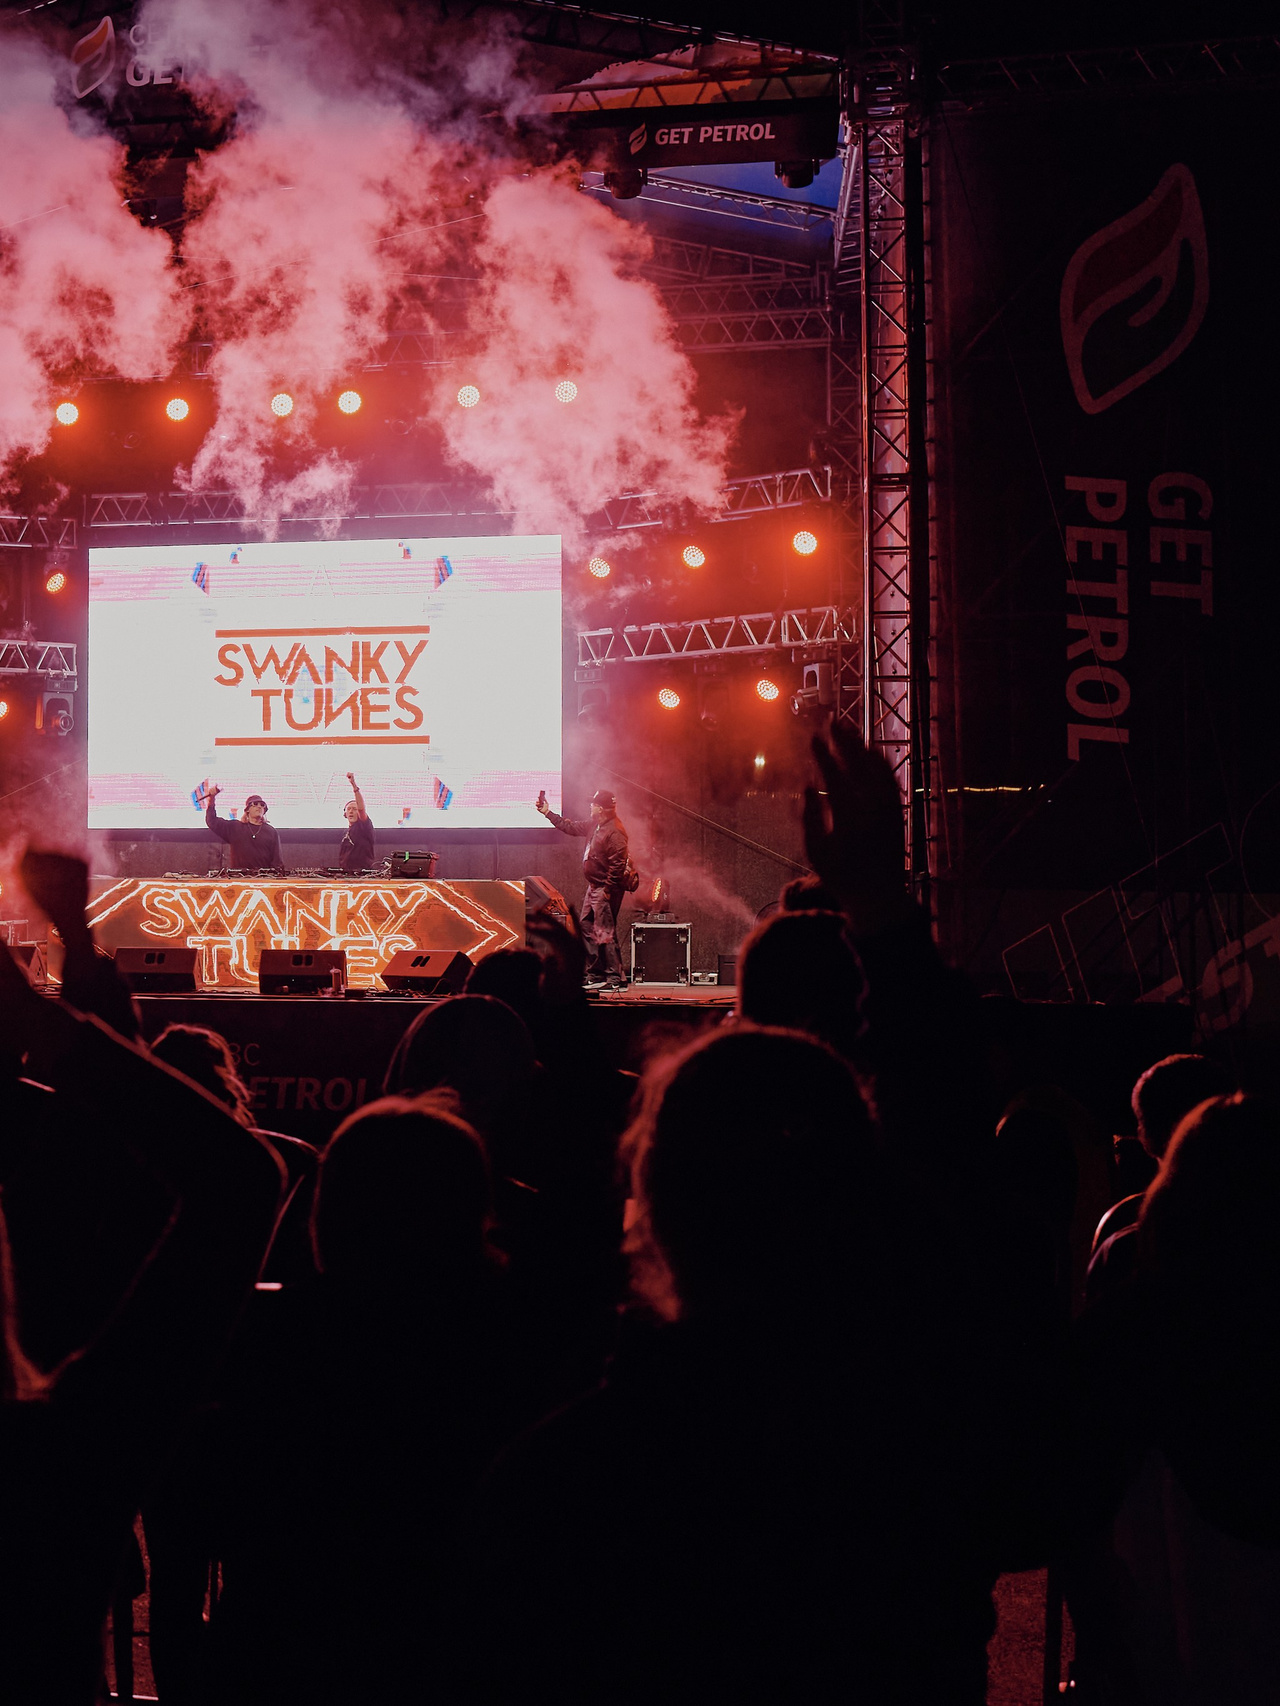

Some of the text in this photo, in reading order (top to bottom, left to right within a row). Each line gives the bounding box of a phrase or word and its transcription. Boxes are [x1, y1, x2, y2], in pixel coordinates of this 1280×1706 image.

[654, 122, 776, 146] GET PETROL
[1147, 470, 1214, 617] GET
[1064, 474, 1131, 762] PETROL
[213, 639, 430, 687] SWANKY
[250, 685, 425, 732] TUNES
[139, 887, 428, 938] SWANKY
[186, 934, 417, 987] TUE
[247, 1075, 368, 1112] ETRO
